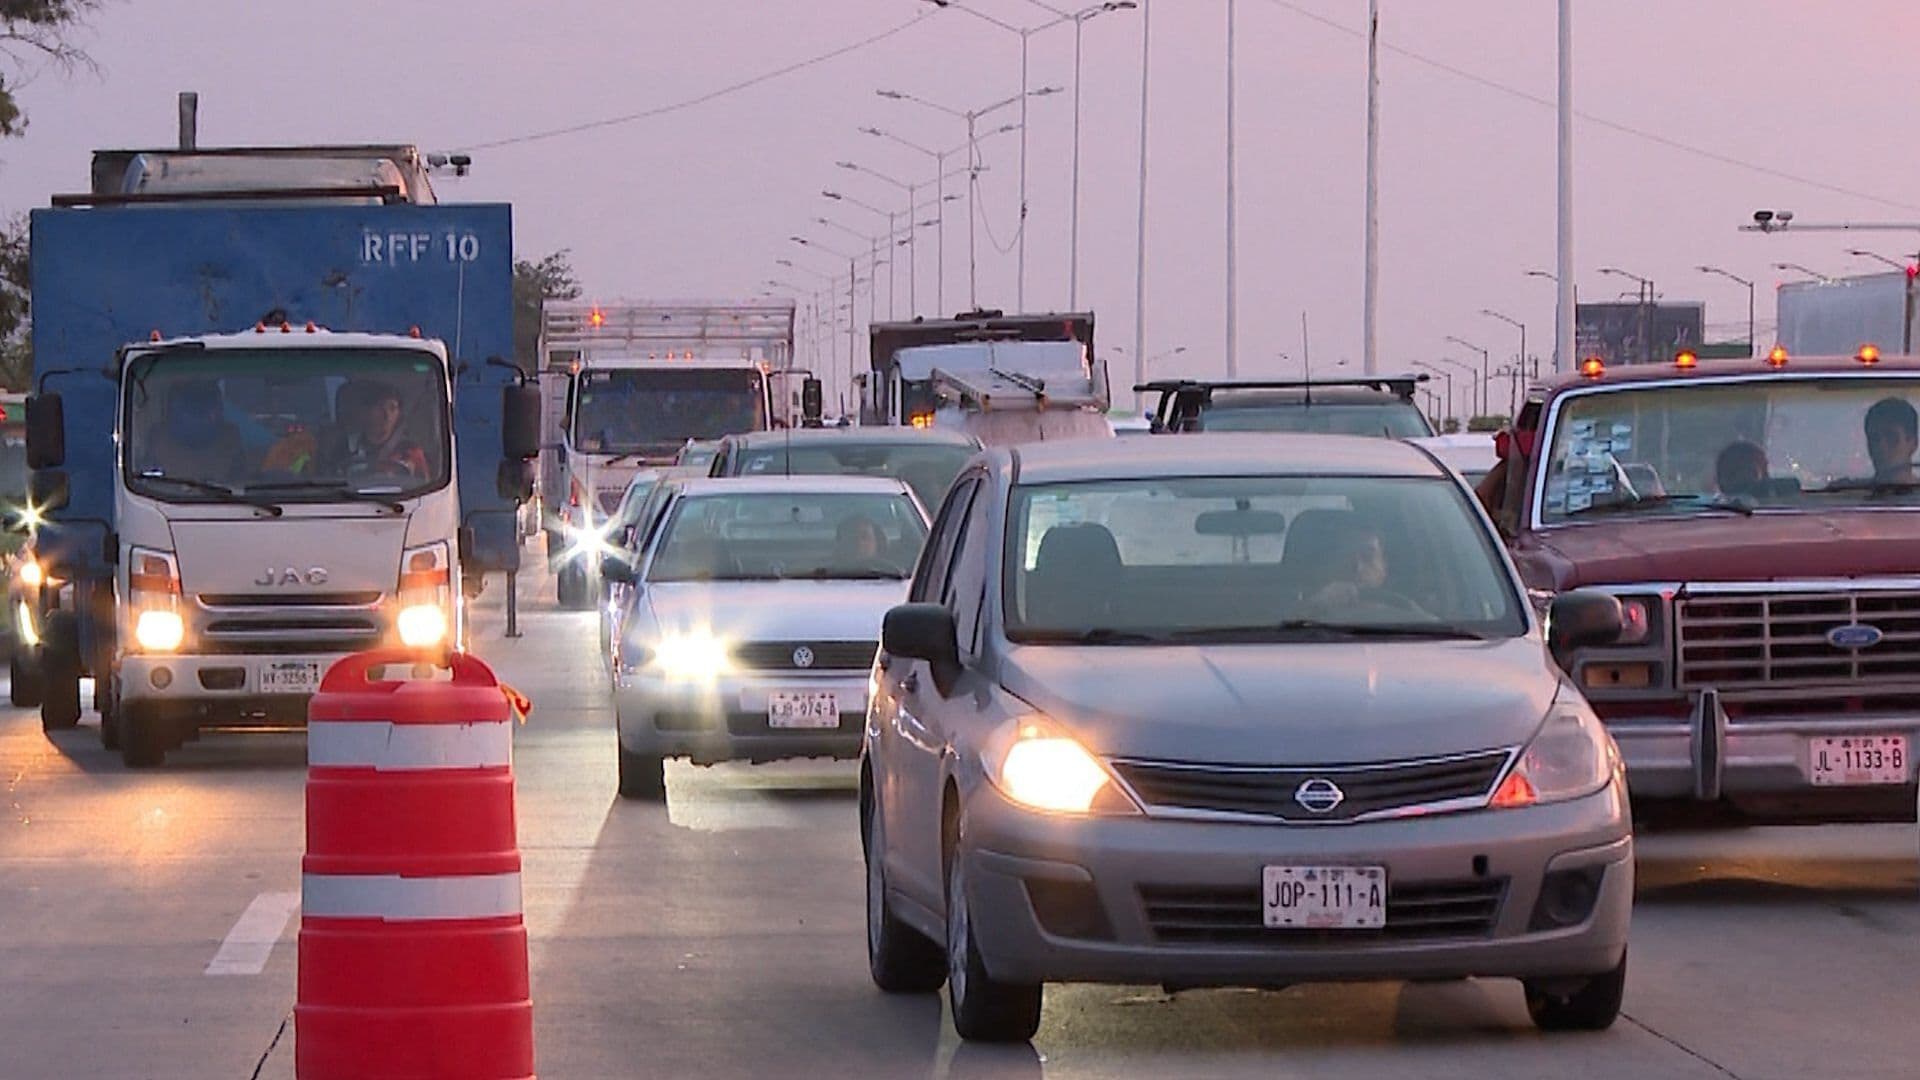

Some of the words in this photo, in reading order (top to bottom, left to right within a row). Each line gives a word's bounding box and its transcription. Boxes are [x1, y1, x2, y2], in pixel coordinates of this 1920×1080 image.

[363, 232, 431, 262] RFF
[446, 233, 480, 261] 10
[1815, 748, 1902, 772] JL-1133-B
[1268, 881, 1381, 908] JOP-111-A
